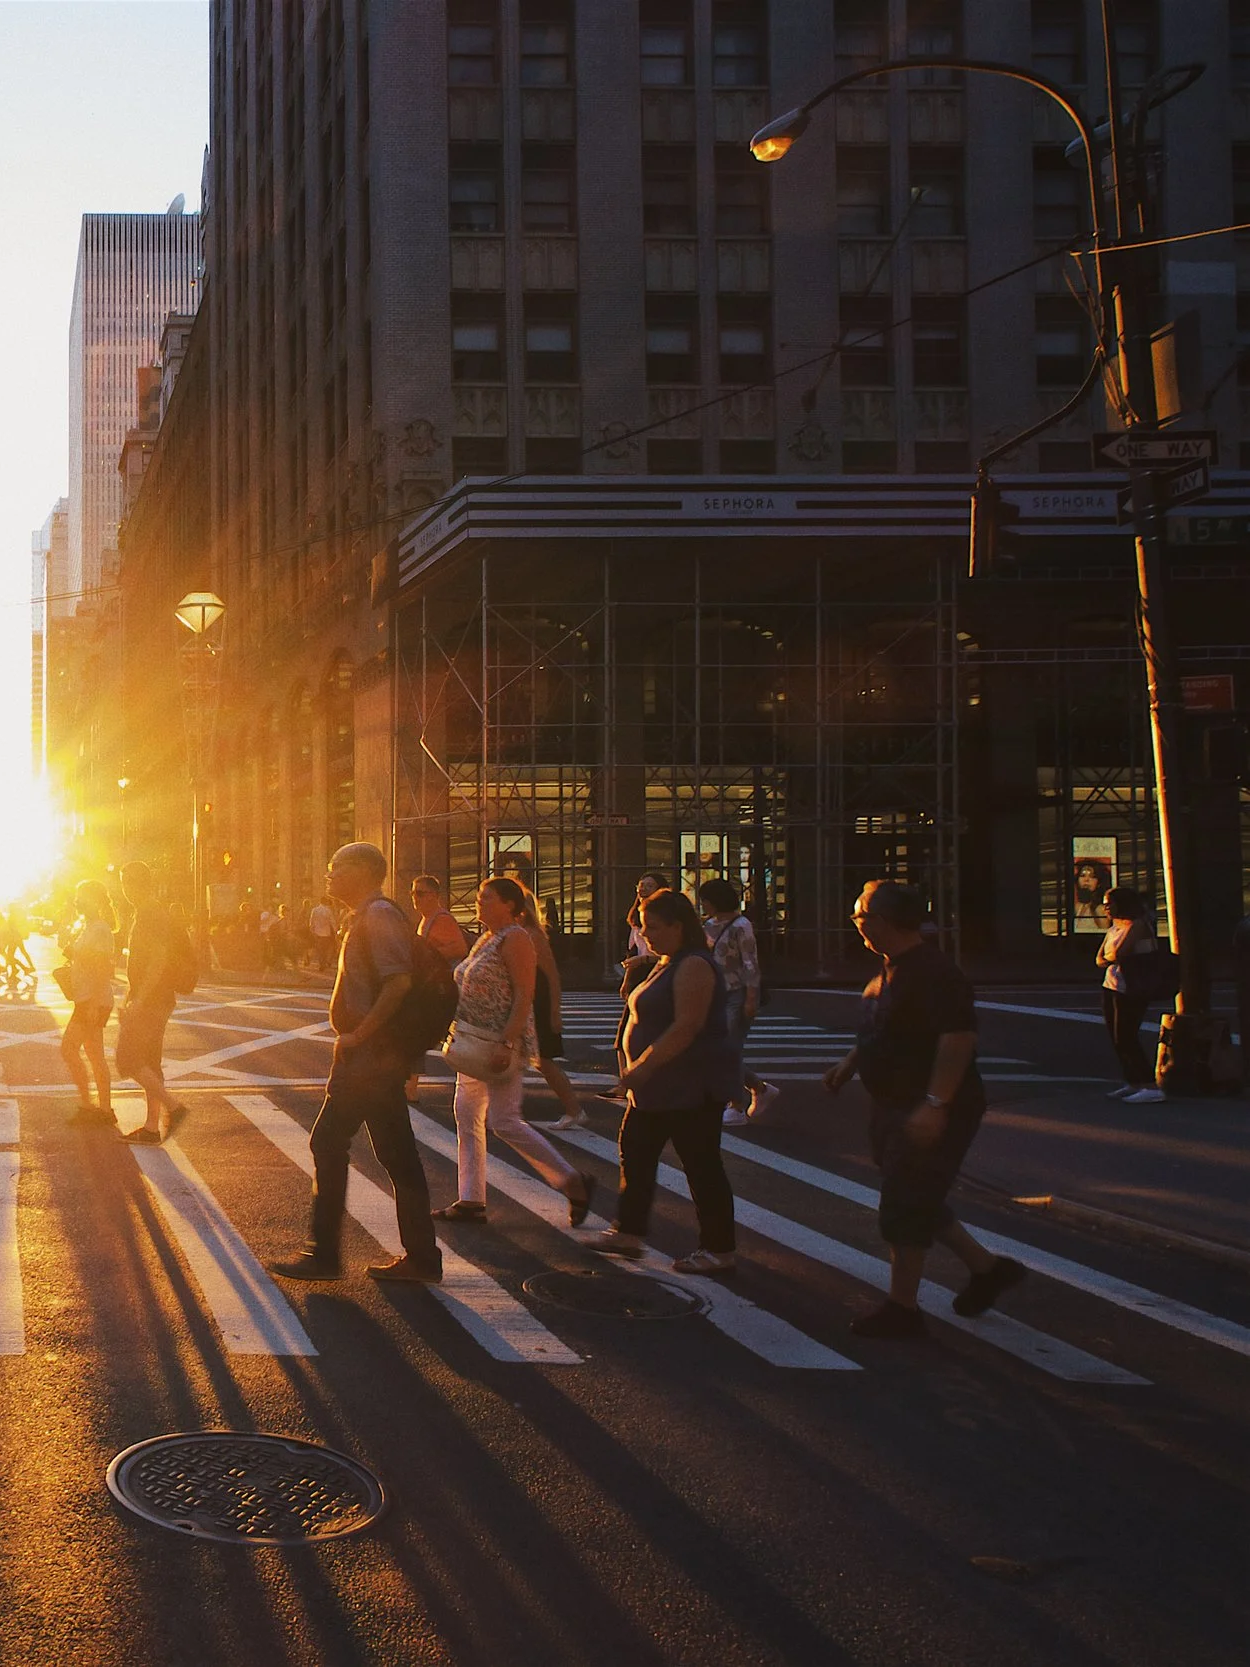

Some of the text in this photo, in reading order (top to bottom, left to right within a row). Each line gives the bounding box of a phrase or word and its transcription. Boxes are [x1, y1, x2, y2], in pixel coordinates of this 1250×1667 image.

[1116, 442, 1204, 457] ONE WAY
[1171, 472, 1198, 496] WAY
[704, 498, 775, 510] SEPHORA
[1033, 496, 1106, 509] SEPHORA
[1196, 519, 1210, 540] 5
